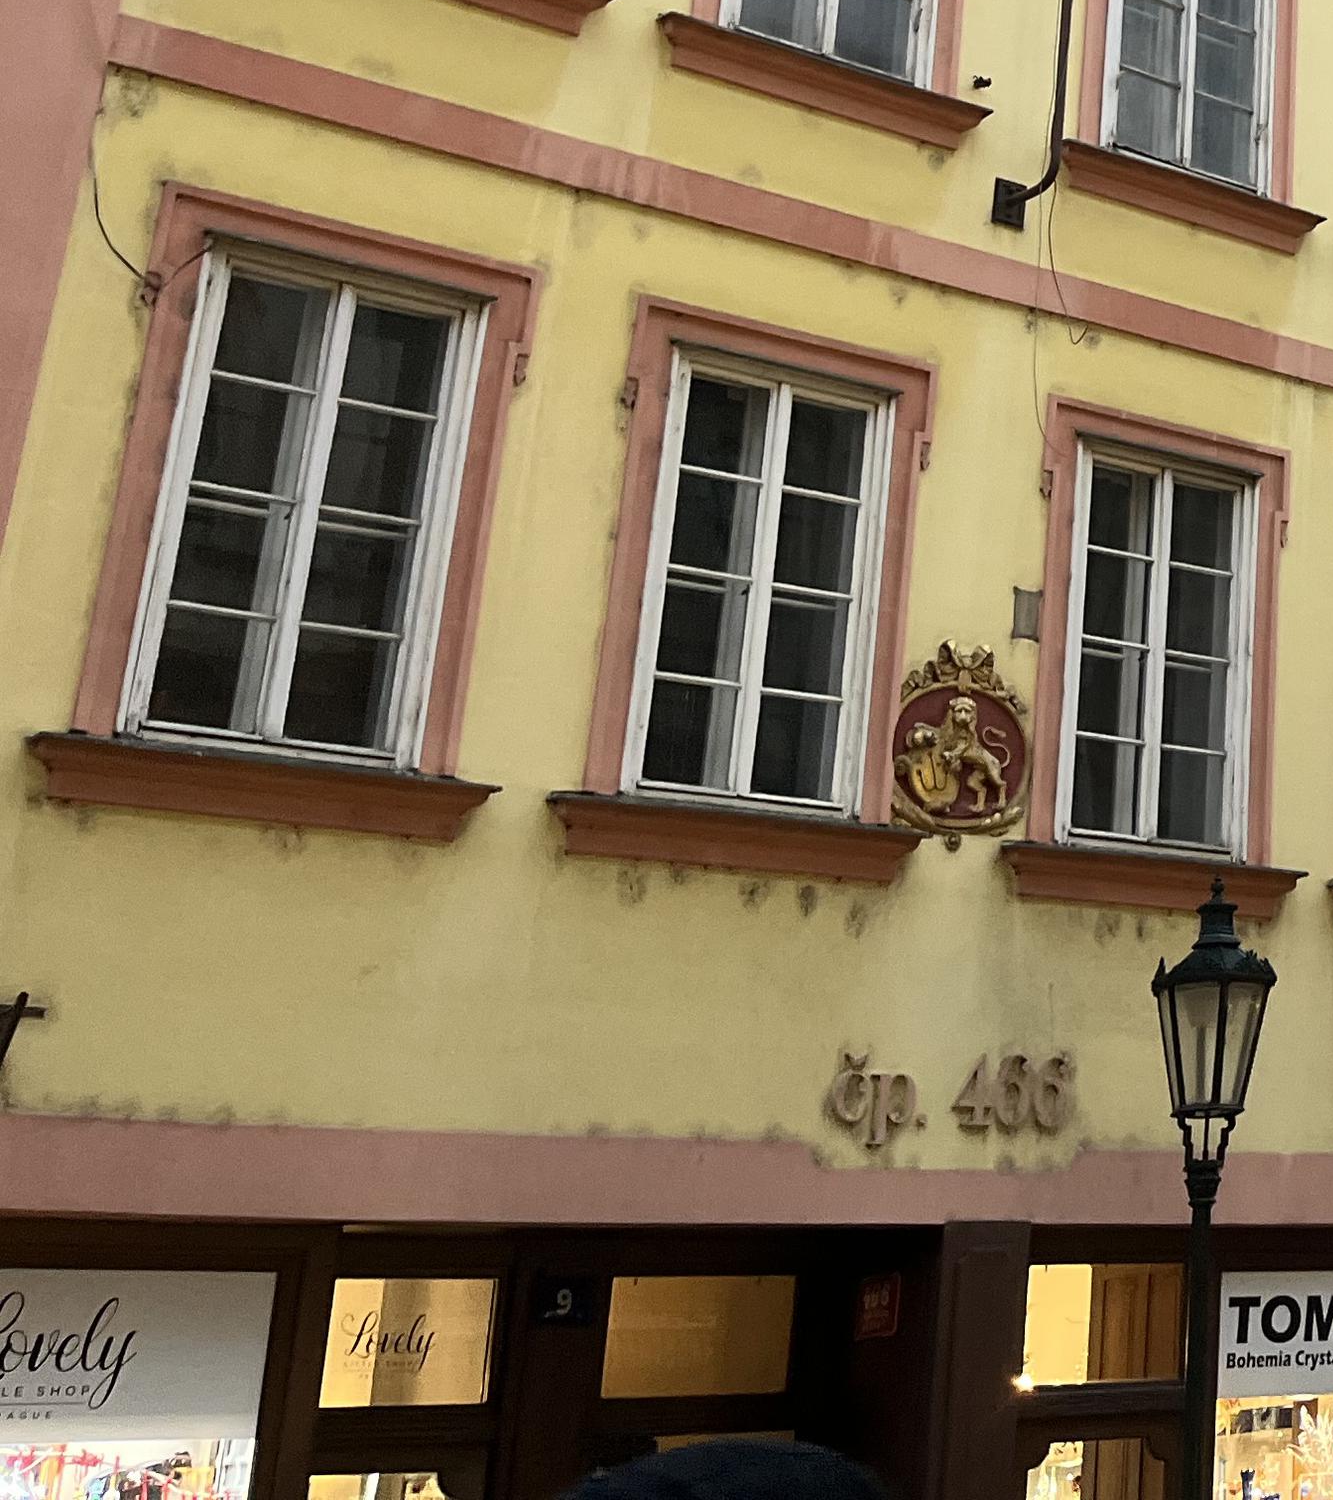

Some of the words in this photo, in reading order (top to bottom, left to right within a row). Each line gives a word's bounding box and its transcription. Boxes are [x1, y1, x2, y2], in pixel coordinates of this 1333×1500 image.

[950, 1051, 1070, 1130] 466
[340, 1310, 436, 1374] Lovely
[1226, 1350, 1292, 1369] Bohemia
[36, 1385, 91, 1397] SHOP
